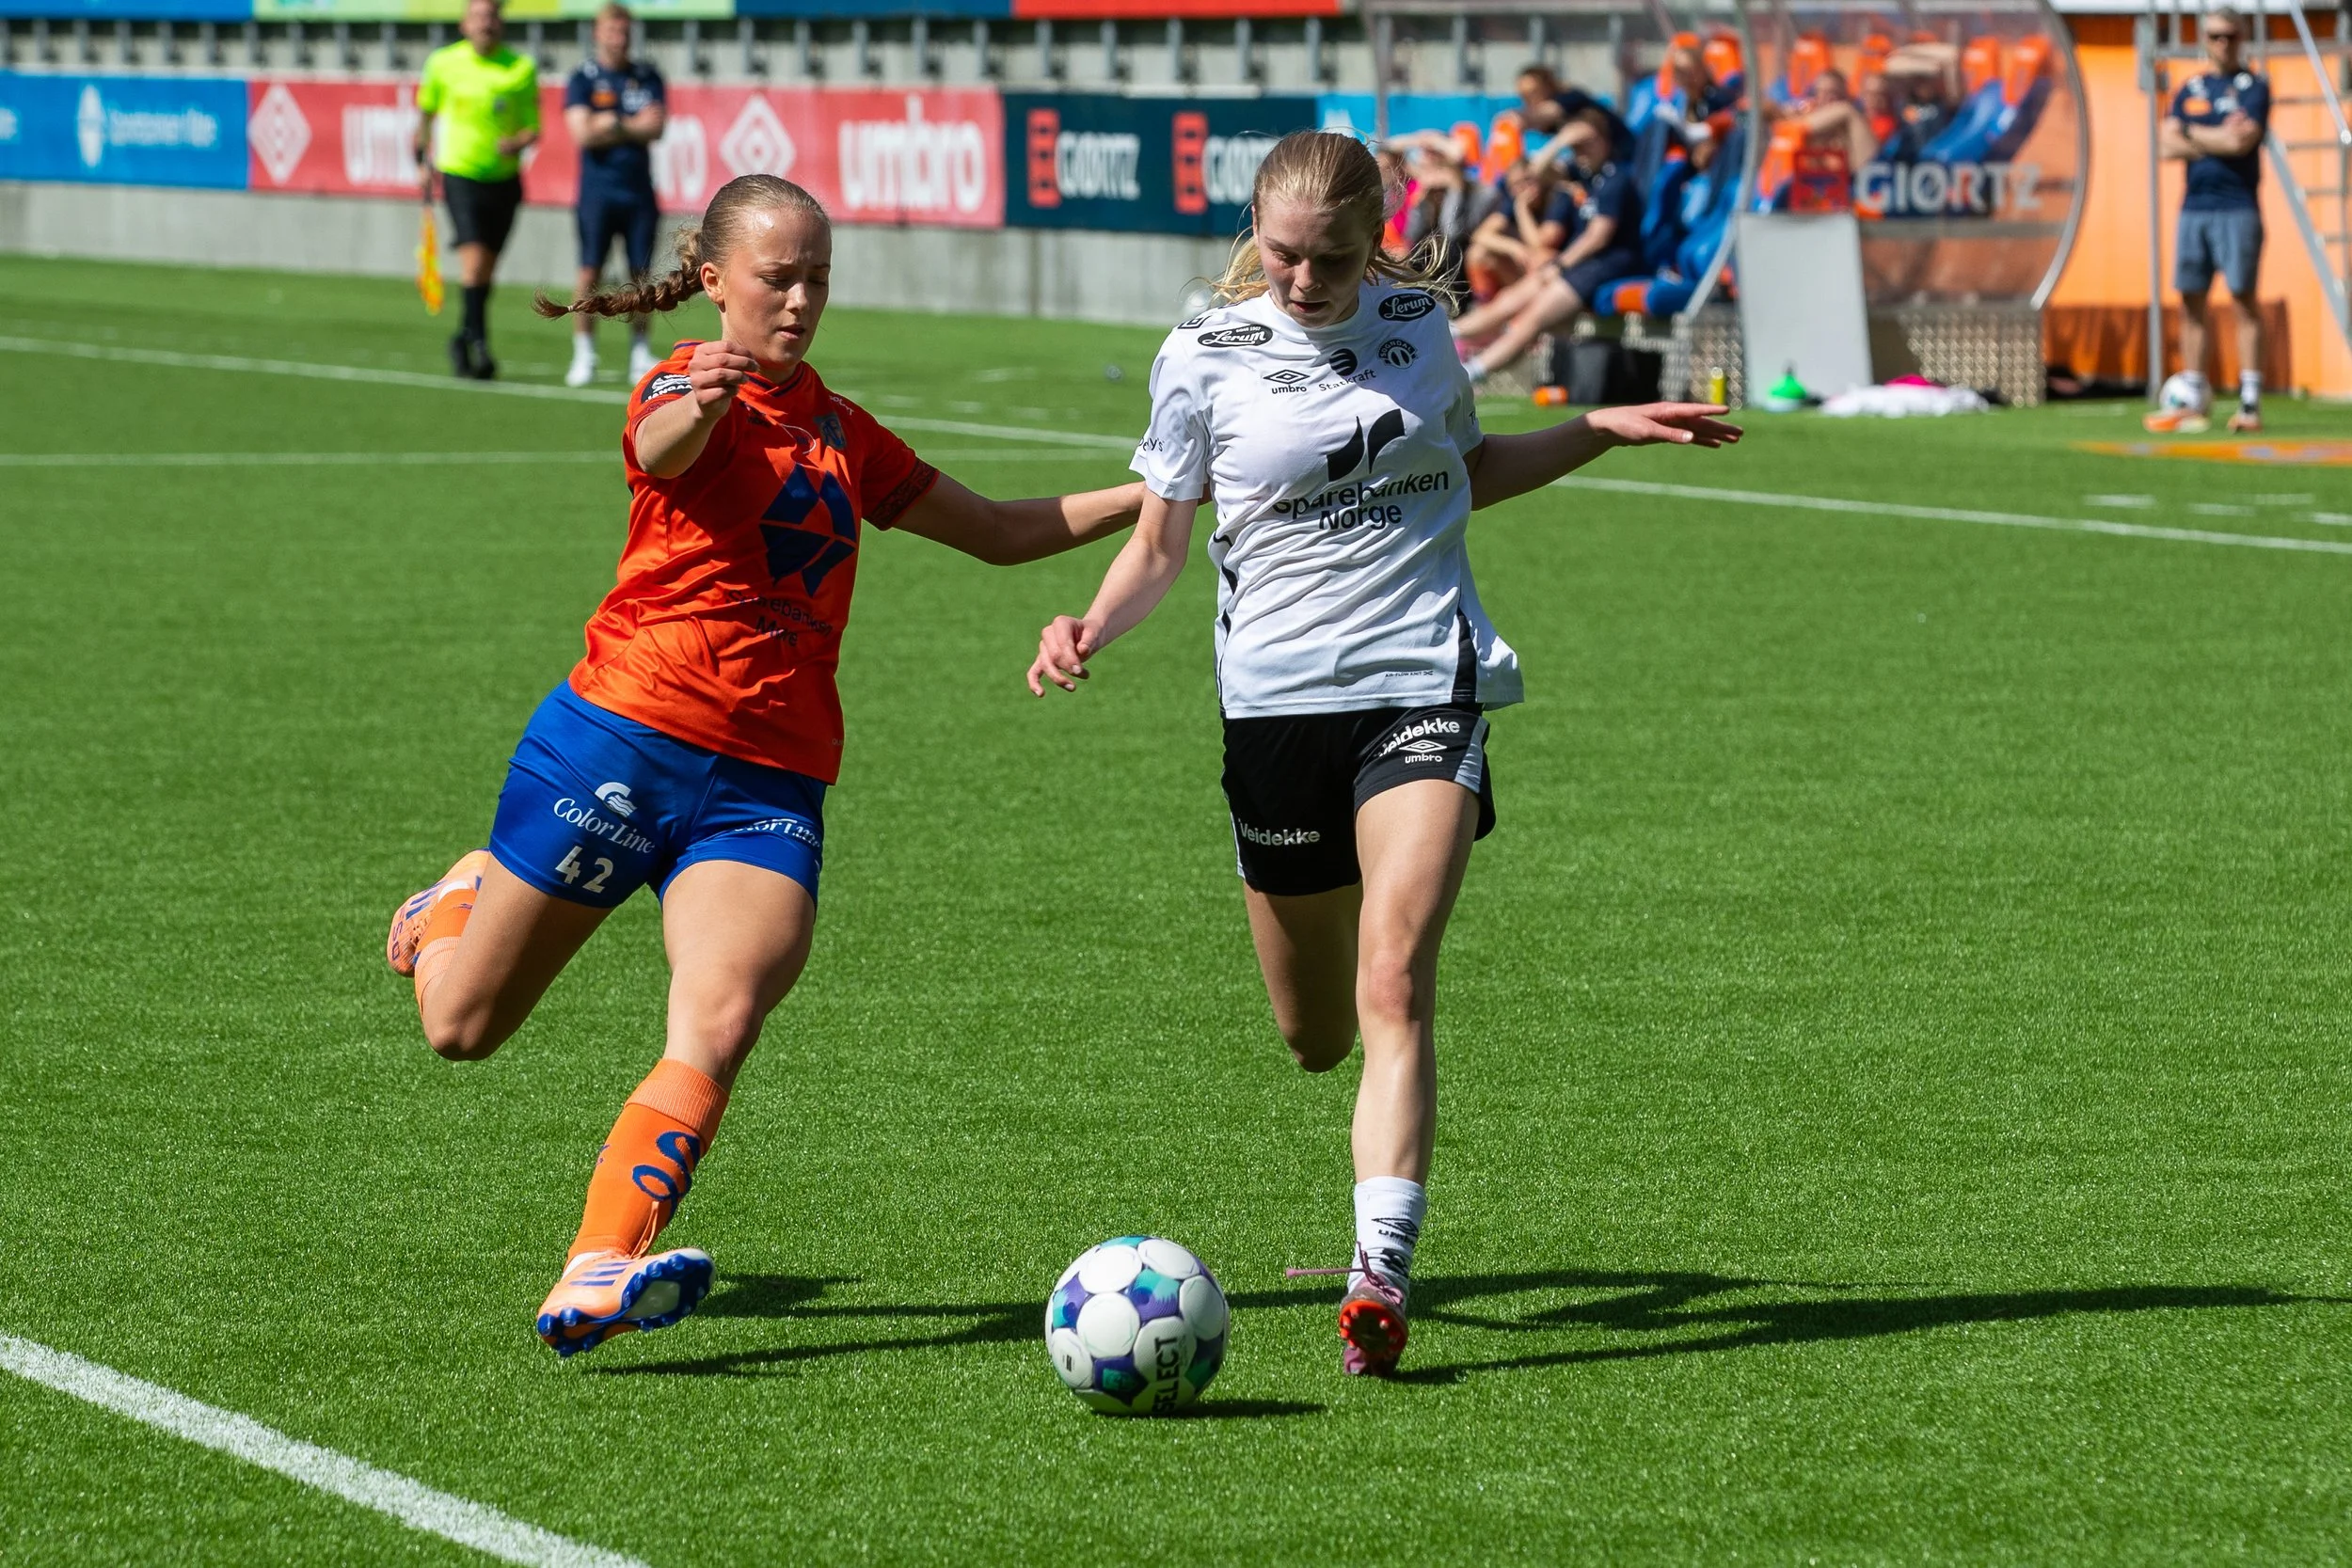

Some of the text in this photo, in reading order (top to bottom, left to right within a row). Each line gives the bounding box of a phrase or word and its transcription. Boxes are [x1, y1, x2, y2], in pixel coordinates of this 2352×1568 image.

[836, 93, 984, 213] umbro
[1381, 295, 1433, 318] Lerum
[1202, 330, 1267, 346] Lerum
[1271, 384, 1308, 394] umbro
[1318, 369, 1377, 391] Statkraft
[1272, 470, 1450, 520] Sparebanken
[1318, 503, 1403, 531] Norge
[1405, 752, 1443, 765] umbro
[1237, 816, 1321, 847] Veidekke
[555, 845, 614, 894] 42
